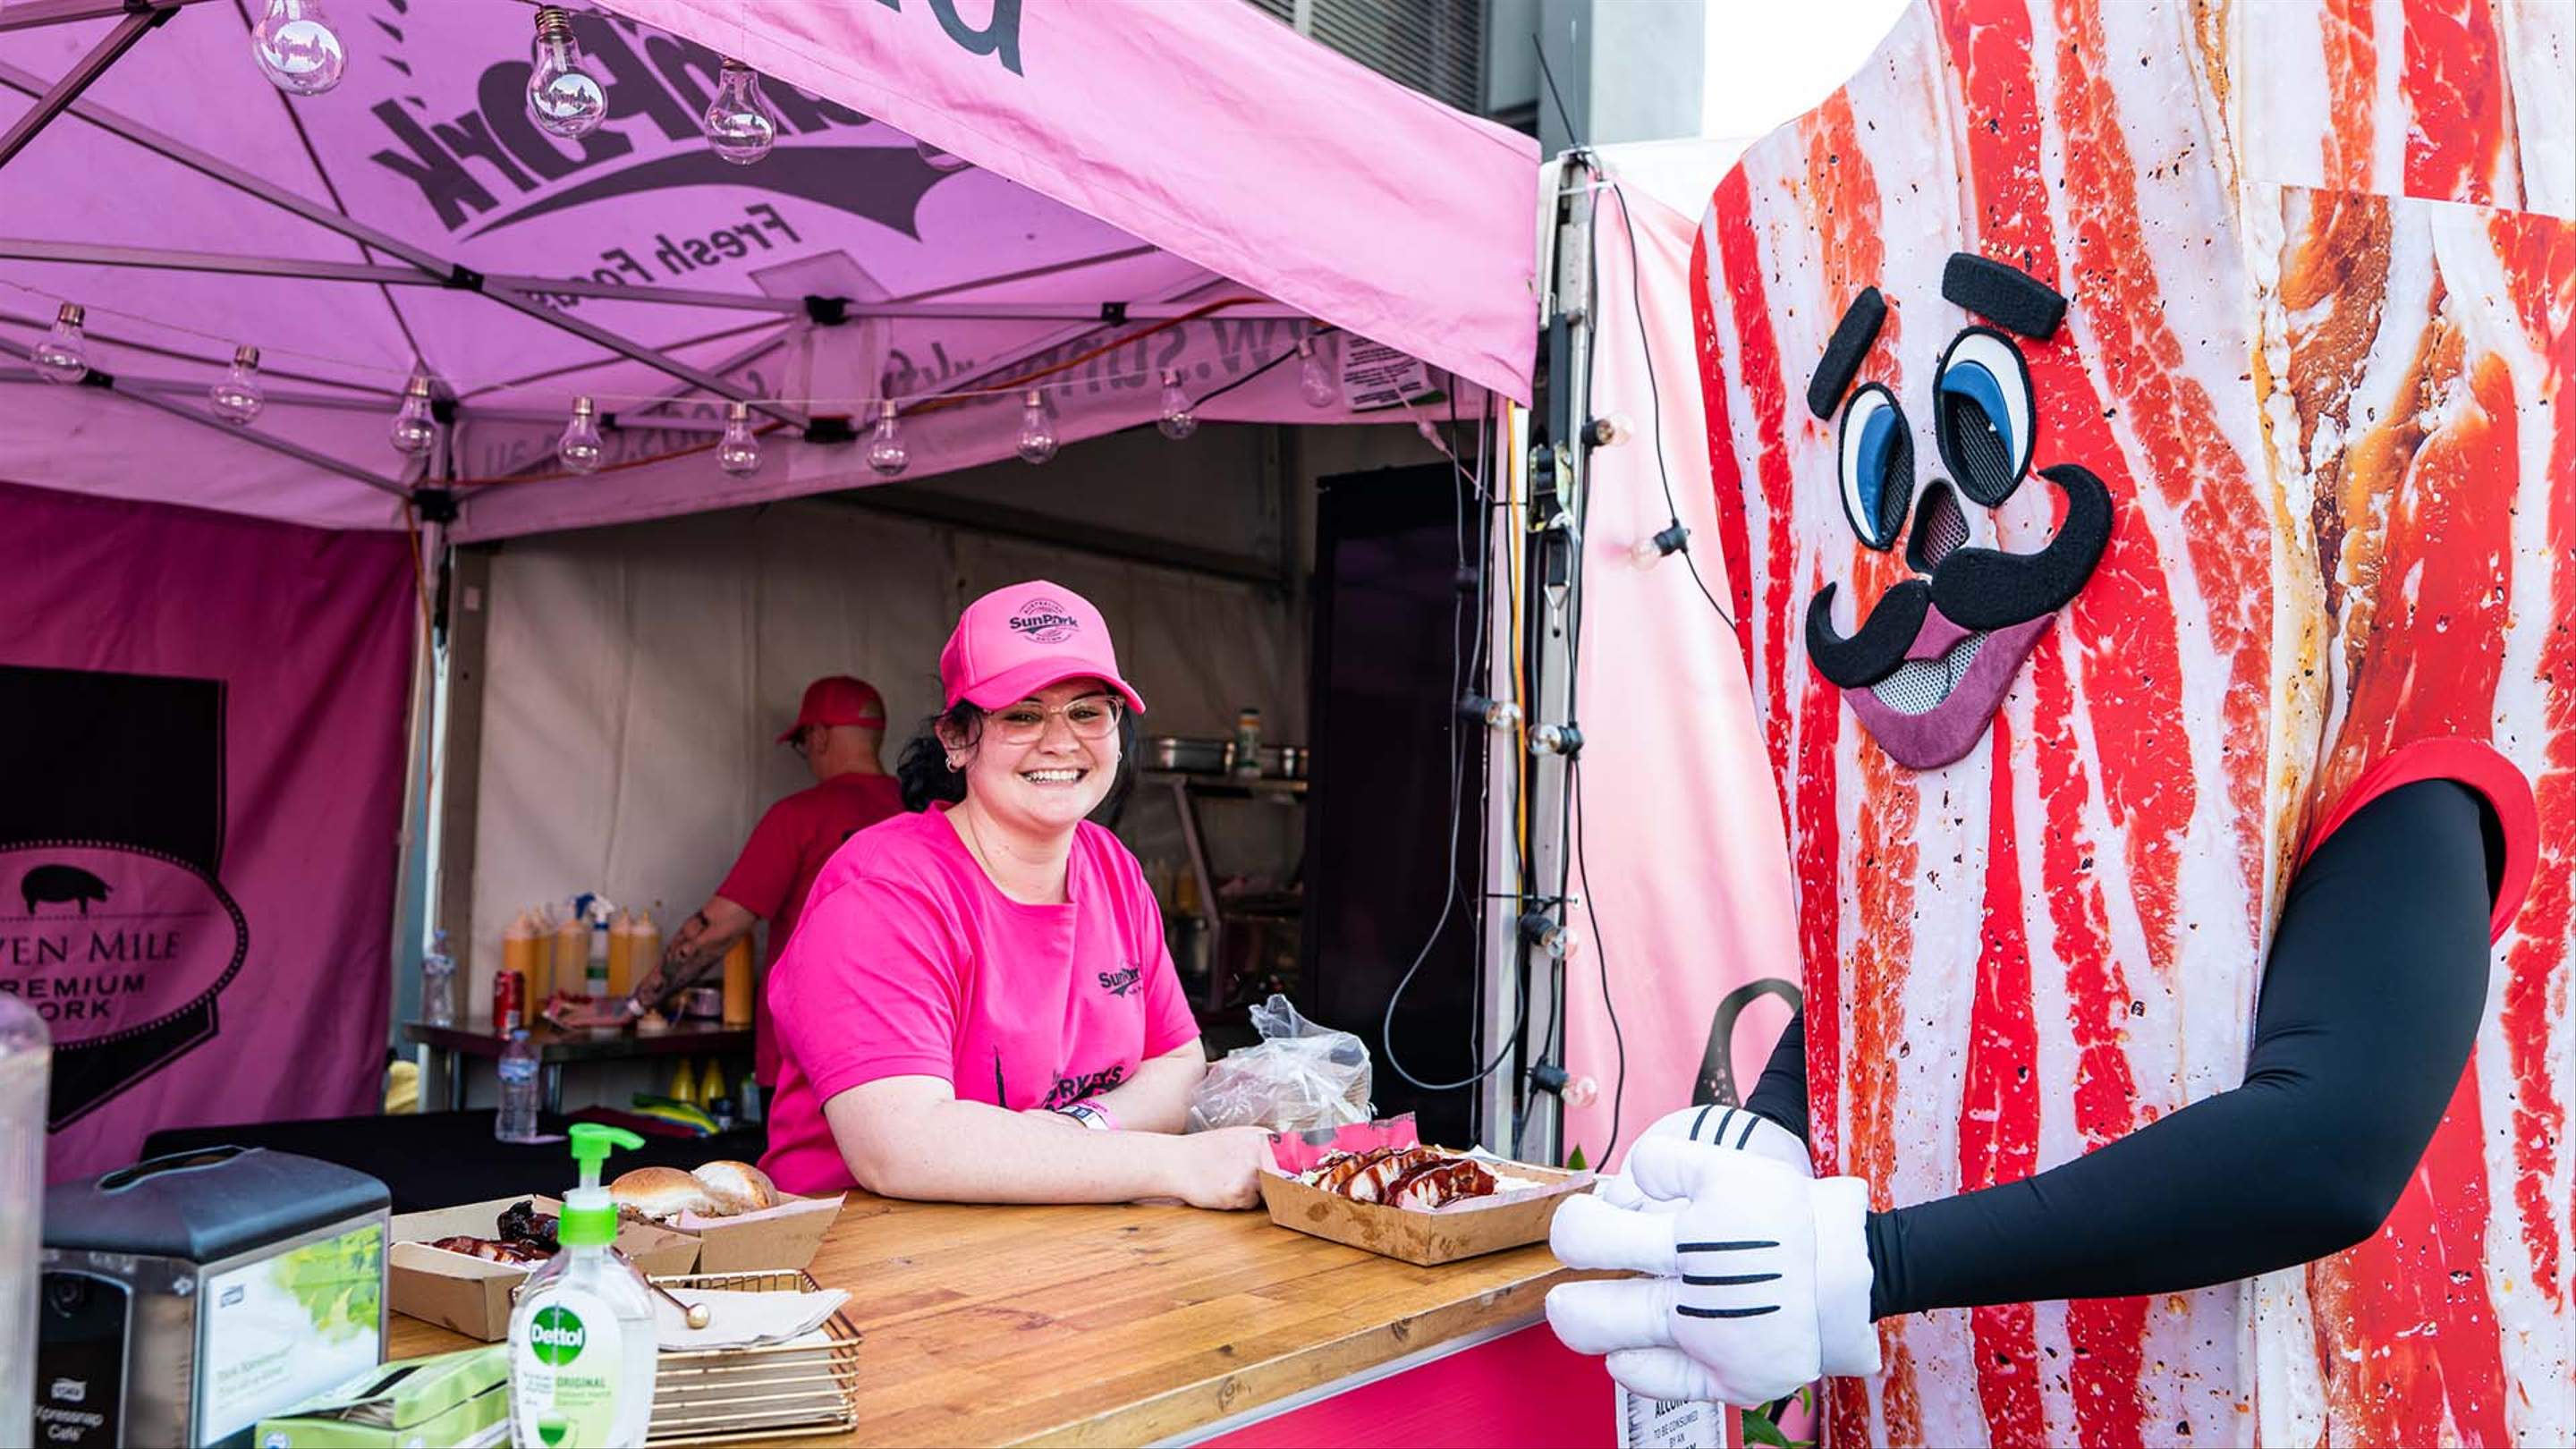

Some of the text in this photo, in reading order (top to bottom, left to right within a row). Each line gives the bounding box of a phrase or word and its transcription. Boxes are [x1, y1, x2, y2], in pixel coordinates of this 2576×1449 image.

[1009, 614, 1079, 629] SunPork
[0, 973, 145, 999] REMIUM
[37, 999, 111, 1022] ORK
[531, 1323, 584, 1347] Dettol
[556, 1376, 606, 1388] ORIGINAL
